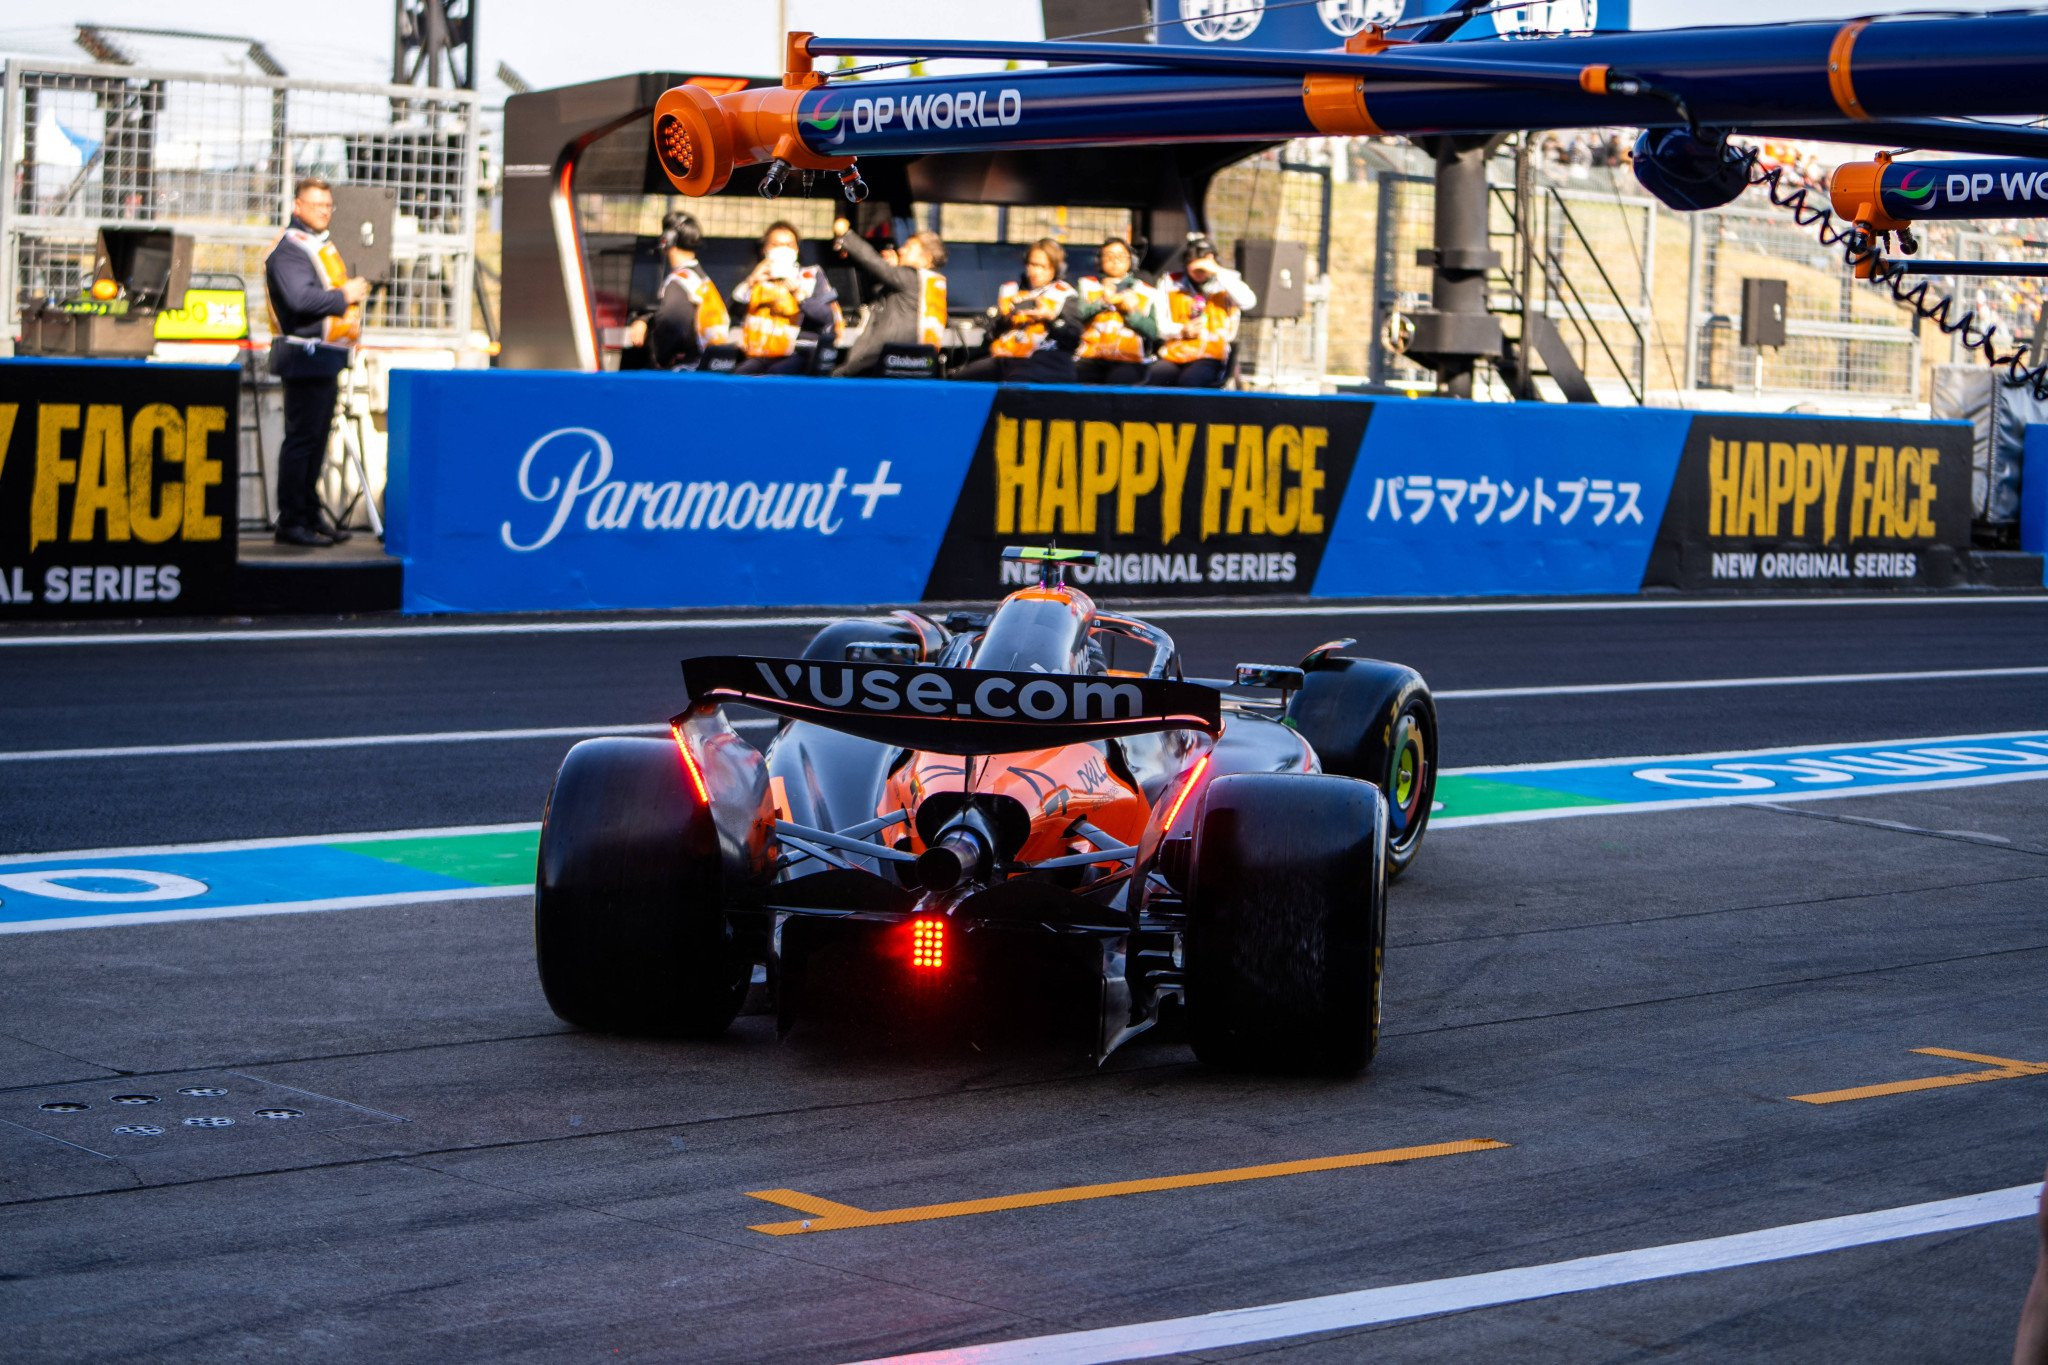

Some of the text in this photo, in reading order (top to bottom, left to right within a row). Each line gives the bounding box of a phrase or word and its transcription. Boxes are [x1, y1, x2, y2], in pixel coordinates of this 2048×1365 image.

[853, 88, 1022, 134] DP WORLD
[1946, 173, 1994, 202] DP
[30, 402, 229, 554] FACE
[501, 426, 902, 552] Paramount+
[995, 411, 1330, 546] HAPPY FACE
[1367, 475, 1645, 527] パラマウントプラス
[1708, 436, 1941, 546] HAPPY FACE
[44, 564, 182, 602] SERIES
[1072, 552, 1203, 585] ORIGINAL
[1208, 552, 1298, 583] SERIES
[1712, 552, 1917, 578] NEW ORIGINAL SERIES
